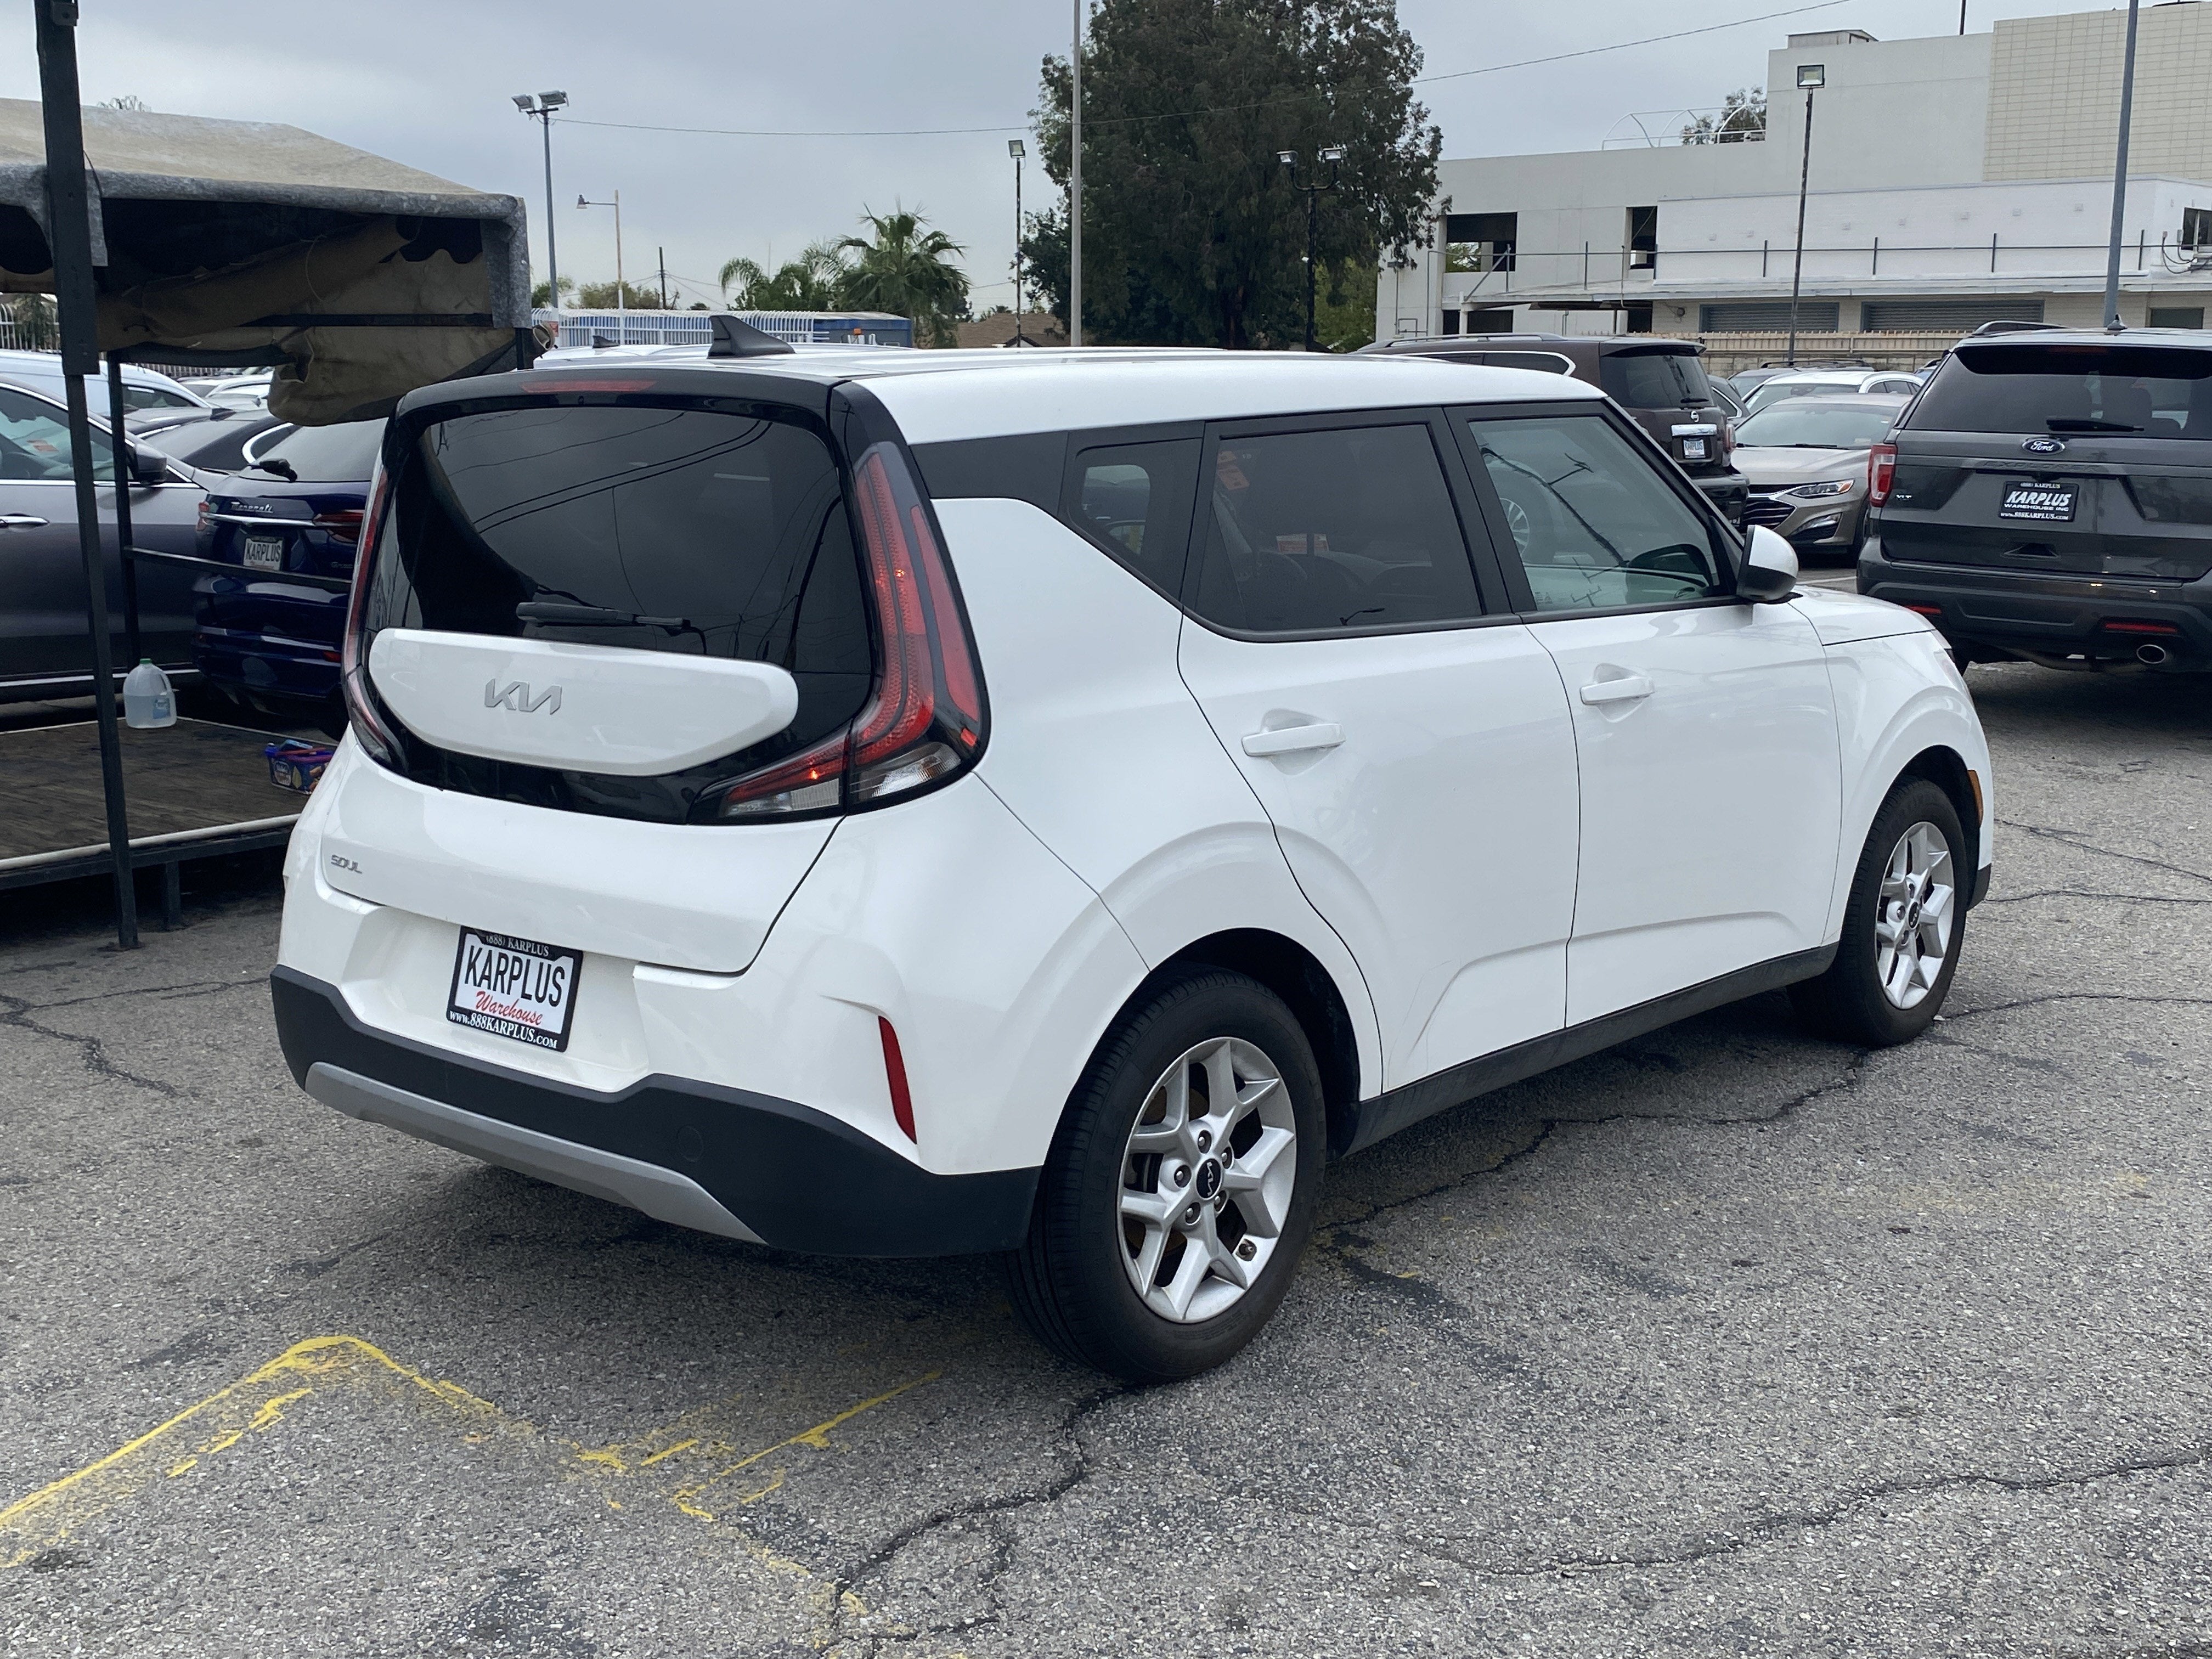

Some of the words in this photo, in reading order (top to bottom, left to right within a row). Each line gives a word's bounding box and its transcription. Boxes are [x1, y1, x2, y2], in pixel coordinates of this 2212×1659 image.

[2030, 441, 2054, 452] Ford
[2006, 490, 2072, 506] KARPLUS
[246, 543, 281, 562] KARPLUS
[484, 678, 562, 715] KIA
[330, 854, 362, 874] SOUL
[486, 934, 506, 946] (888)
[507, 938, 550, 957] KARPLUS
[464, 945, 566, 1007] KARPLUS
[476, 990, 543, 1026] Warehouse
